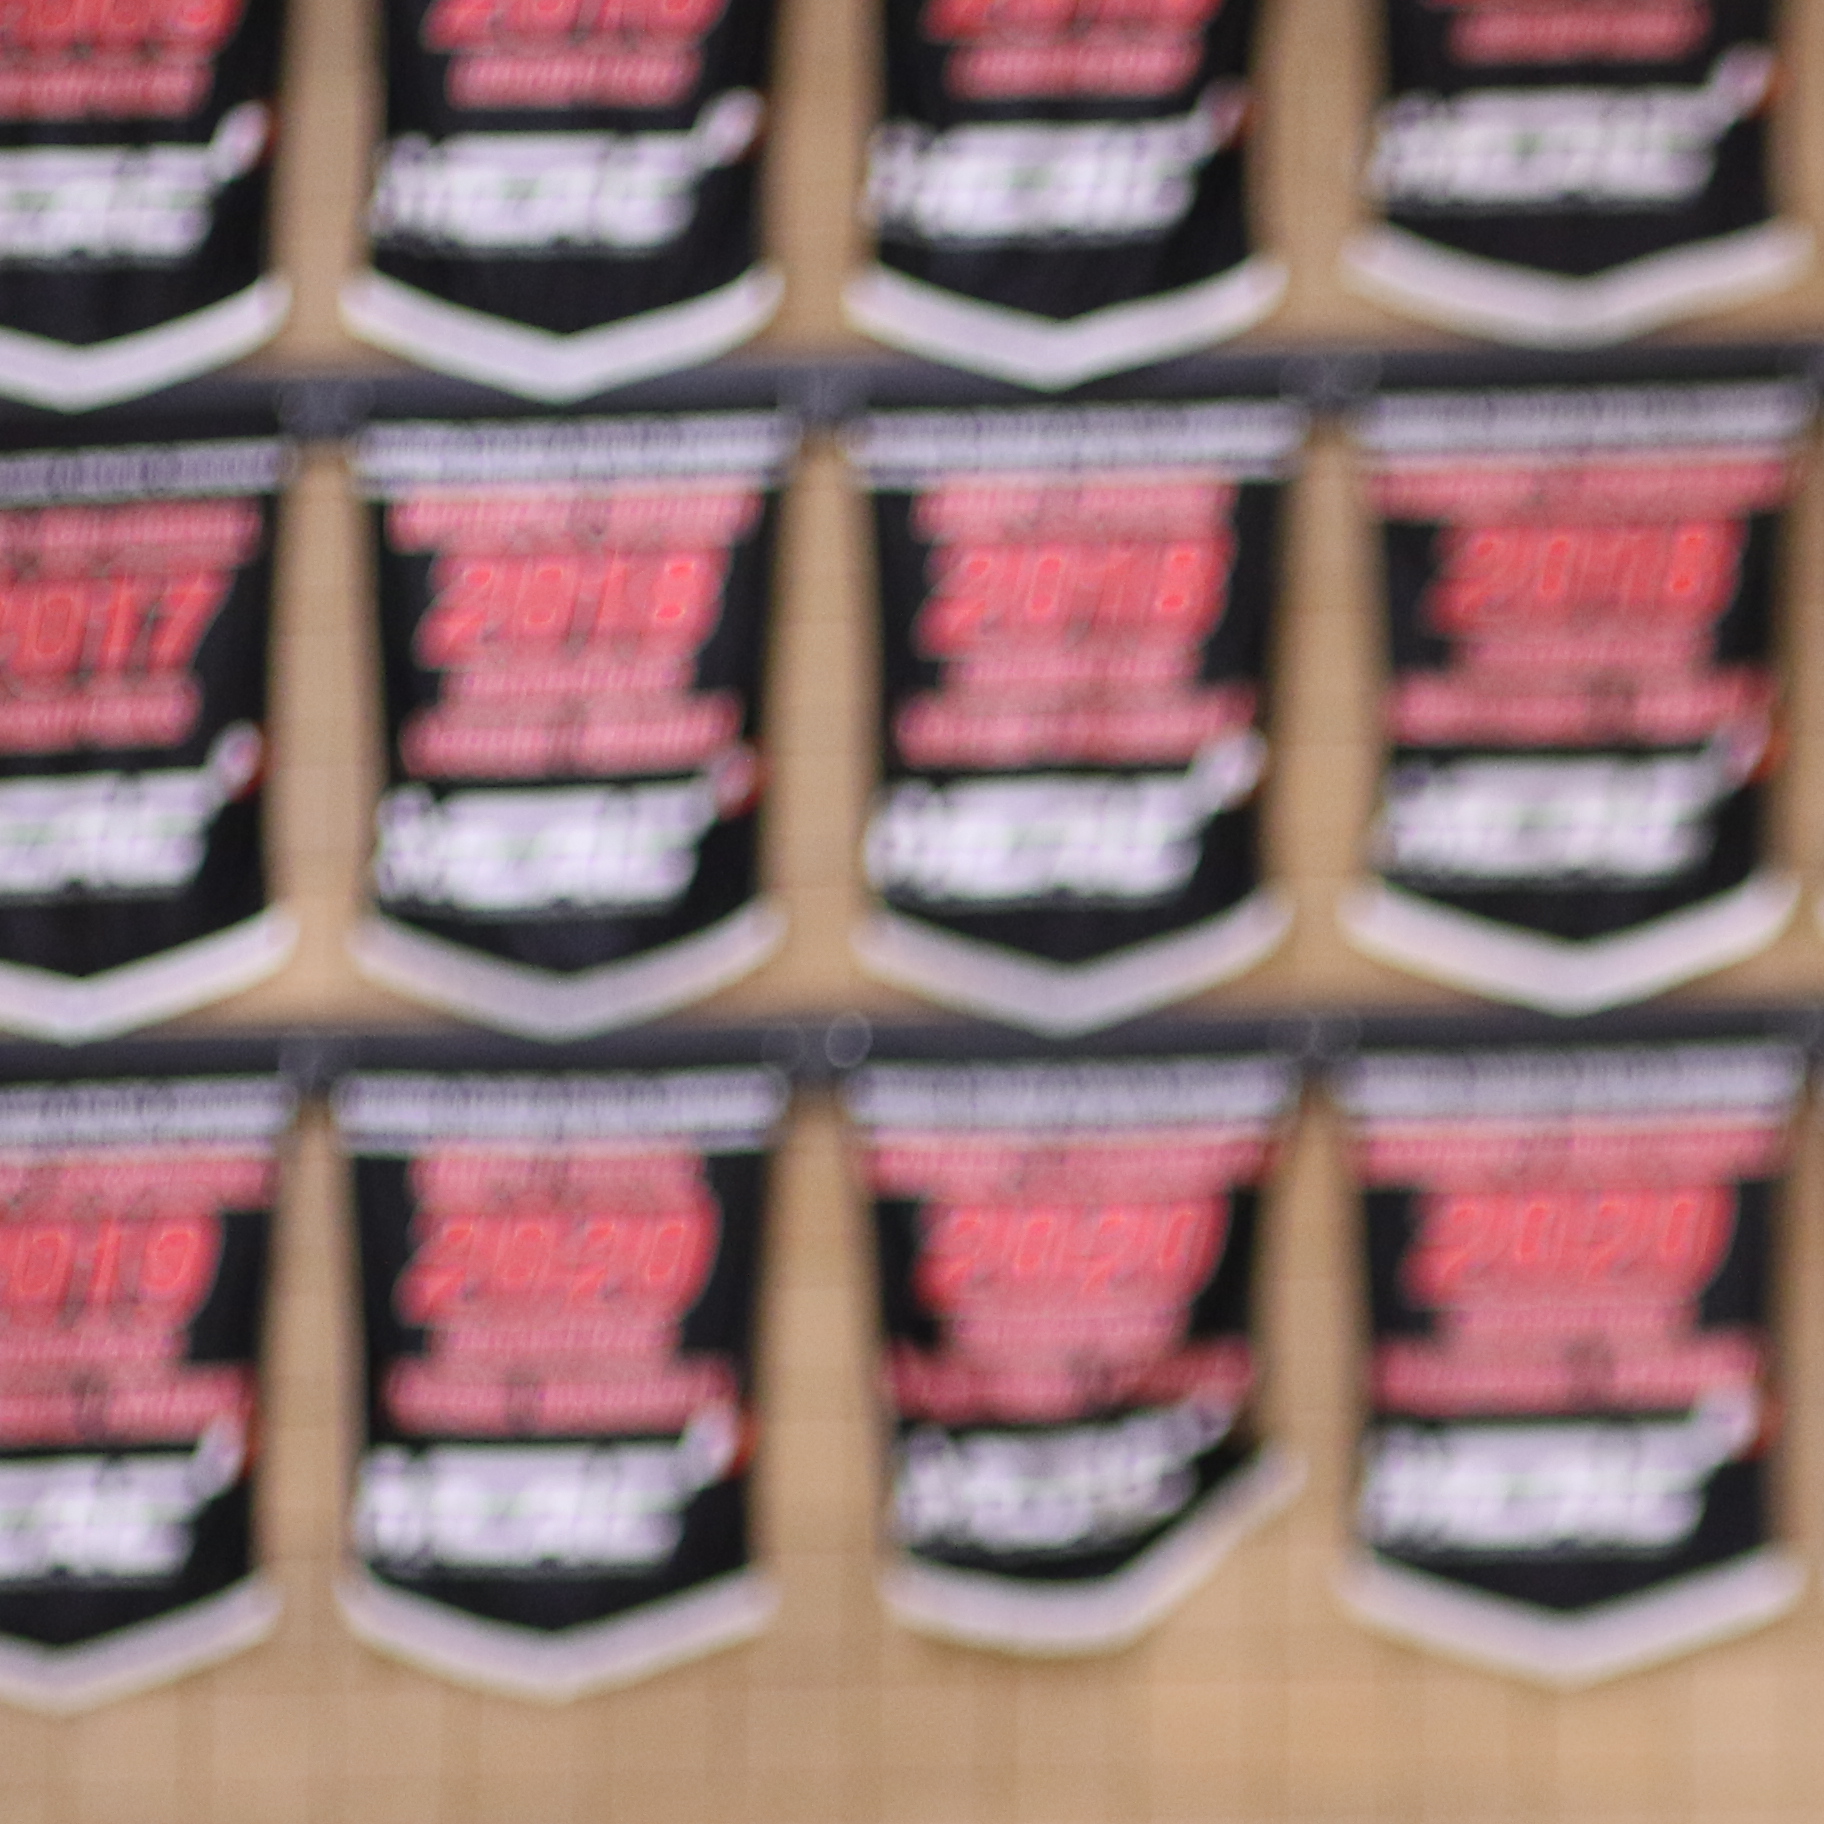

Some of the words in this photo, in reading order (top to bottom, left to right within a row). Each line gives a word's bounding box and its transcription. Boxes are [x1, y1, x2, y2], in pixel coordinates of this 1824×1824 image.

[420, 550, 722, 665] 2018
[917, 536, 1231, 652] 2018
[1432, 525, 1744, 628] 2018
[403, 1209, 718, 1325] 2020
